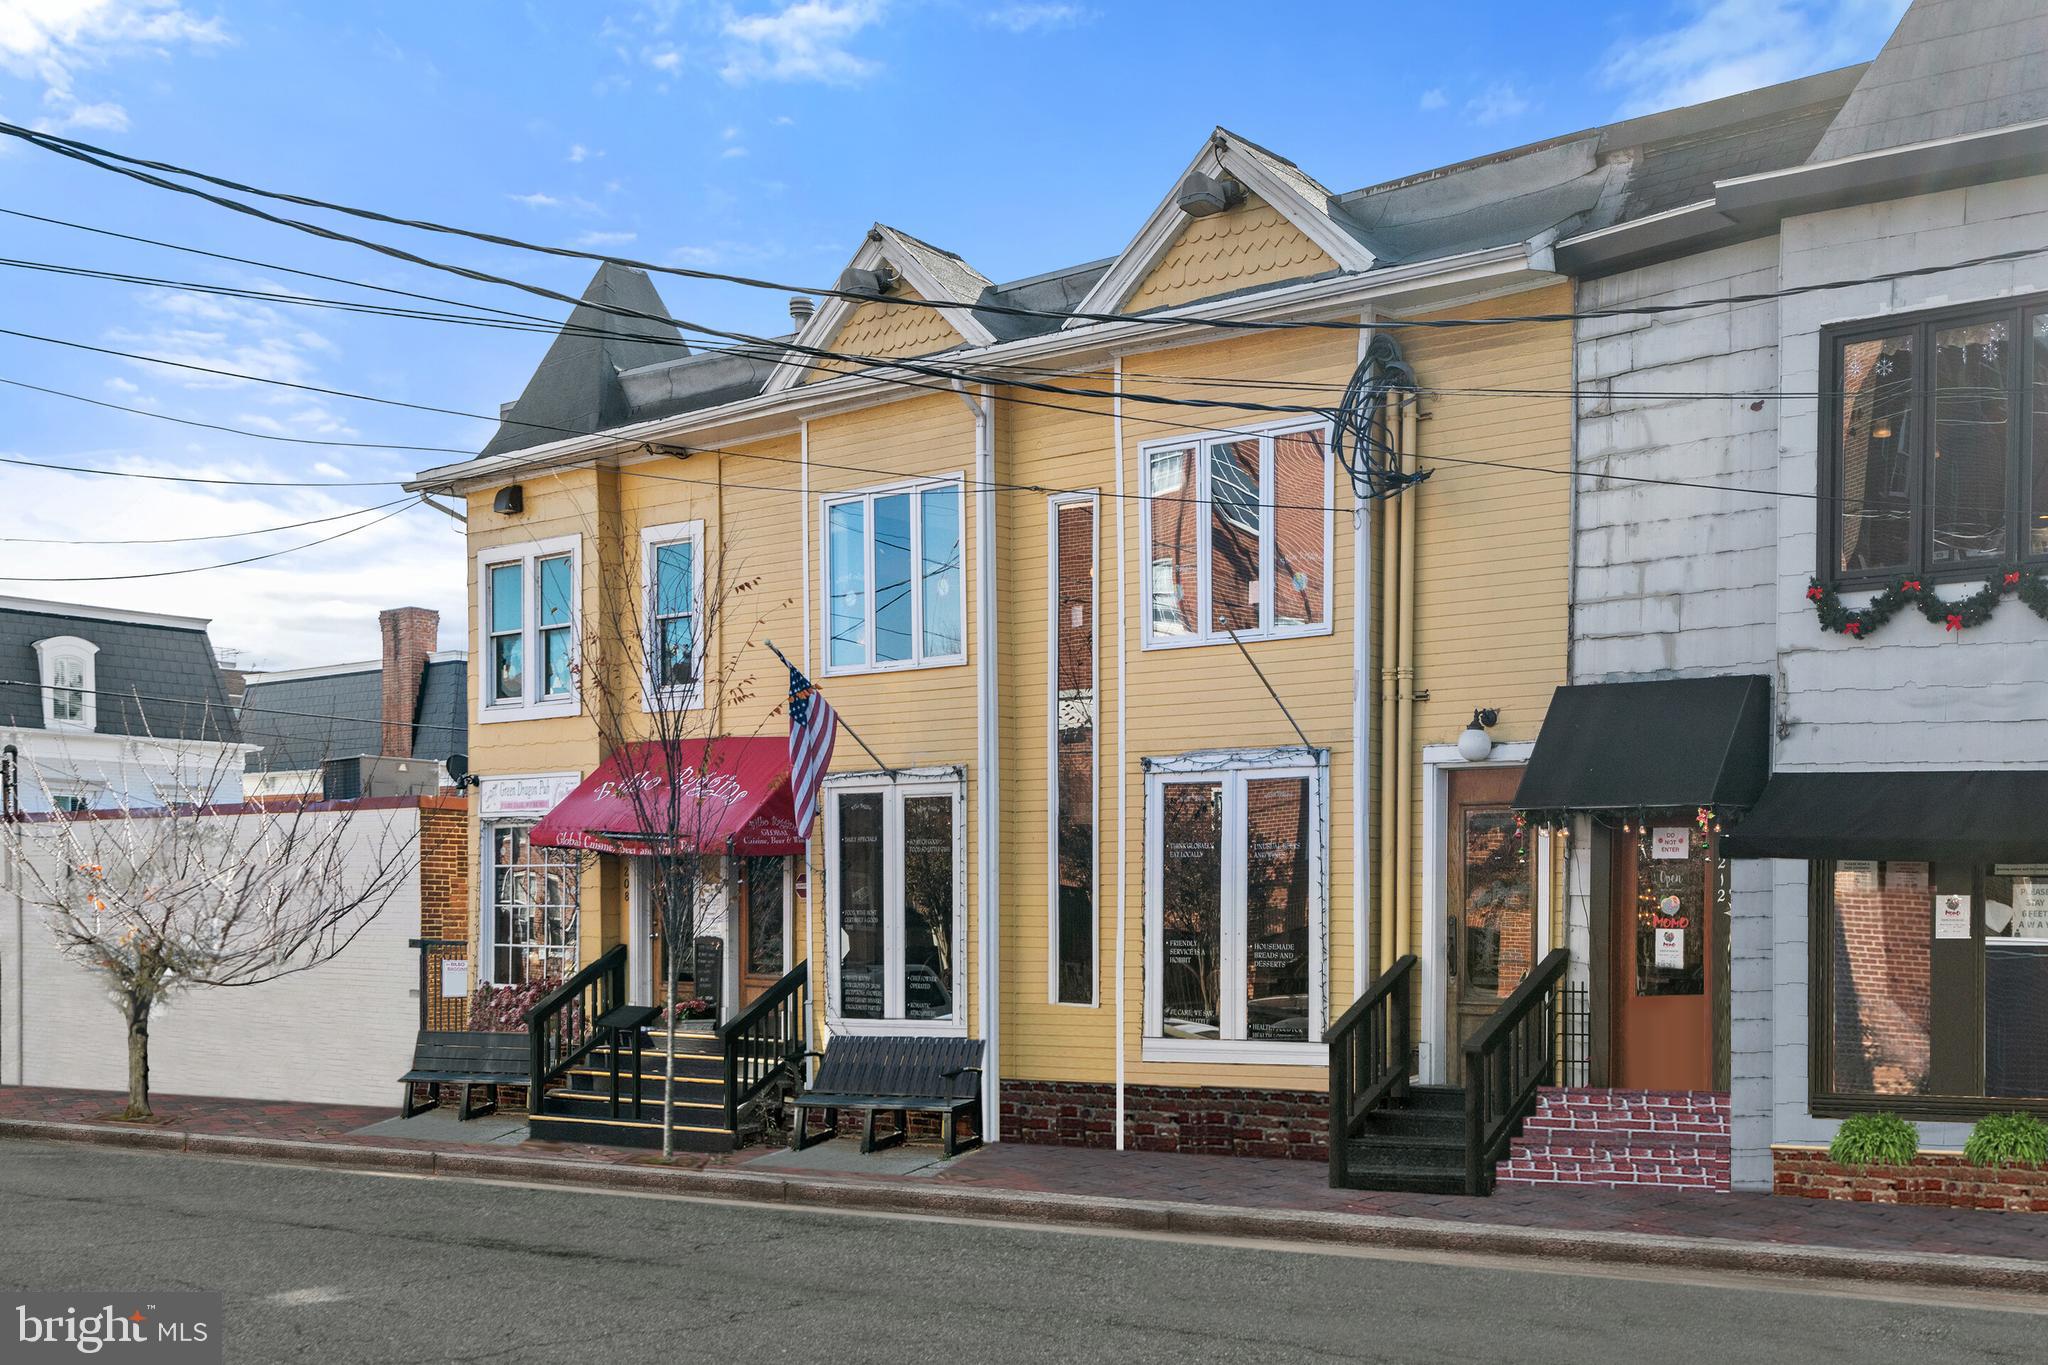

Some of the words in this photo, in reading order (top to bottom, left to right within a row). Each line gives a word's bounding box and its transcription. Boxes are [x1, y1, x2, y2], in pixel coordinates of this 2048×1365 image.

[539, 780, 550, 795] Pub
[760, 829, 788, 837] GLOBAL
[770, 836, 785, 844] Beer
[556, 832, 582, 846] Global
[583, 835, 615, 853] Cuisine,
[1660, 871, 1683, 887] Open
[1717, 857, 1726, 902] 212
[2020, 888, 2048, 896] PEASE
[1652, 915, 1689, 929] MOMO
[1169, 956, 1191, 964] HOBBIT
